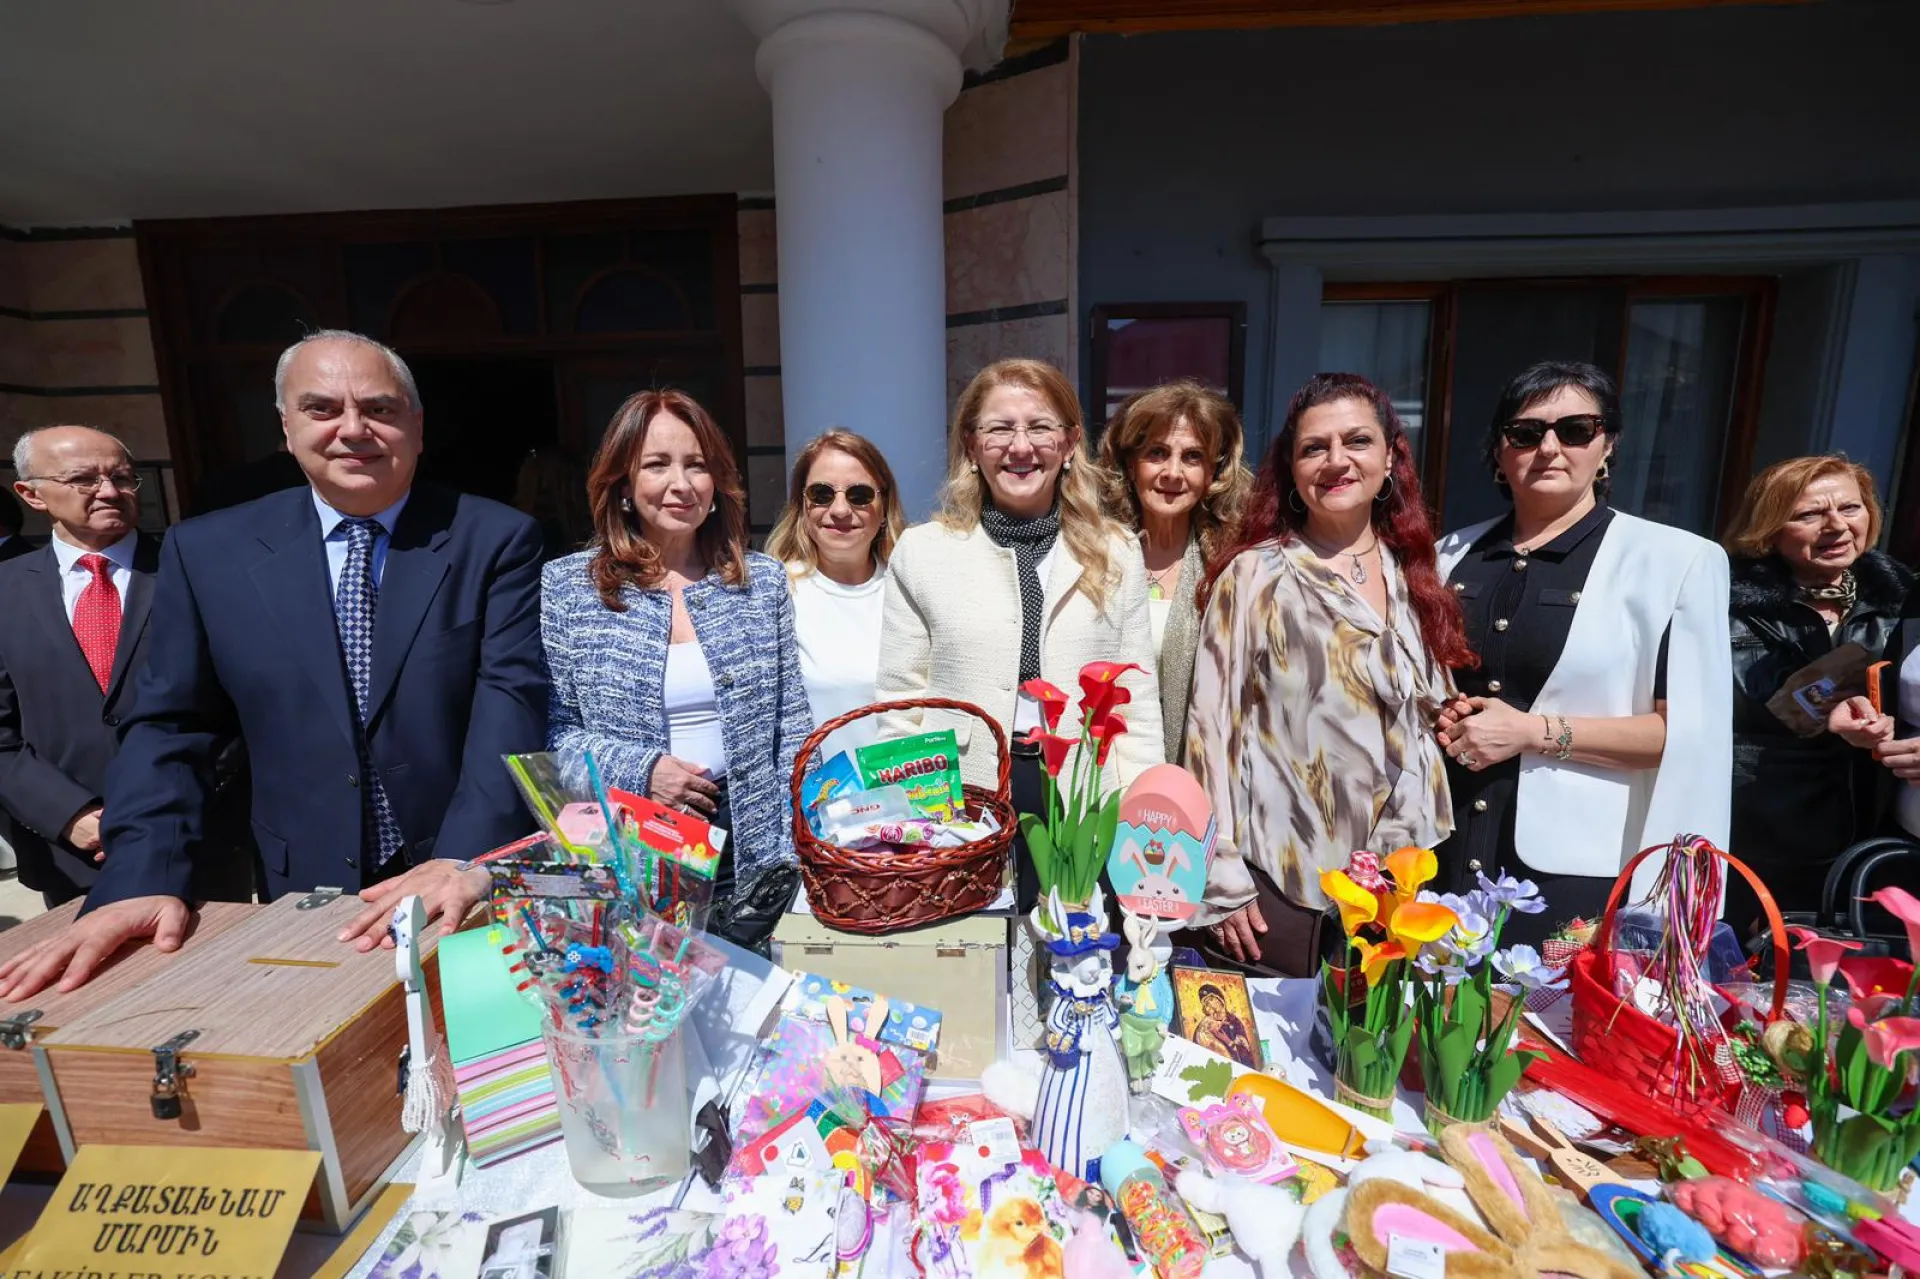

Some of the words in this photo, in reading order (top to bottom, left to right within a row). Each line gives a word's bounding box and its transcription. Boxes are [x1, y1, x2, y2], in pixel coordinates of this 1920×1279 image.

[878, 755, 948, 783] HARIBO
[1143, 809, 1172, 826] HAPPY
[1143, 899, 1175, 913] EASTER
[68, 1183, 286, 1218] ԱՂՔԱՏԱԽՆԱՄ
[93, 1223, 219, 1255] ՄԱՐՄԻՆ
